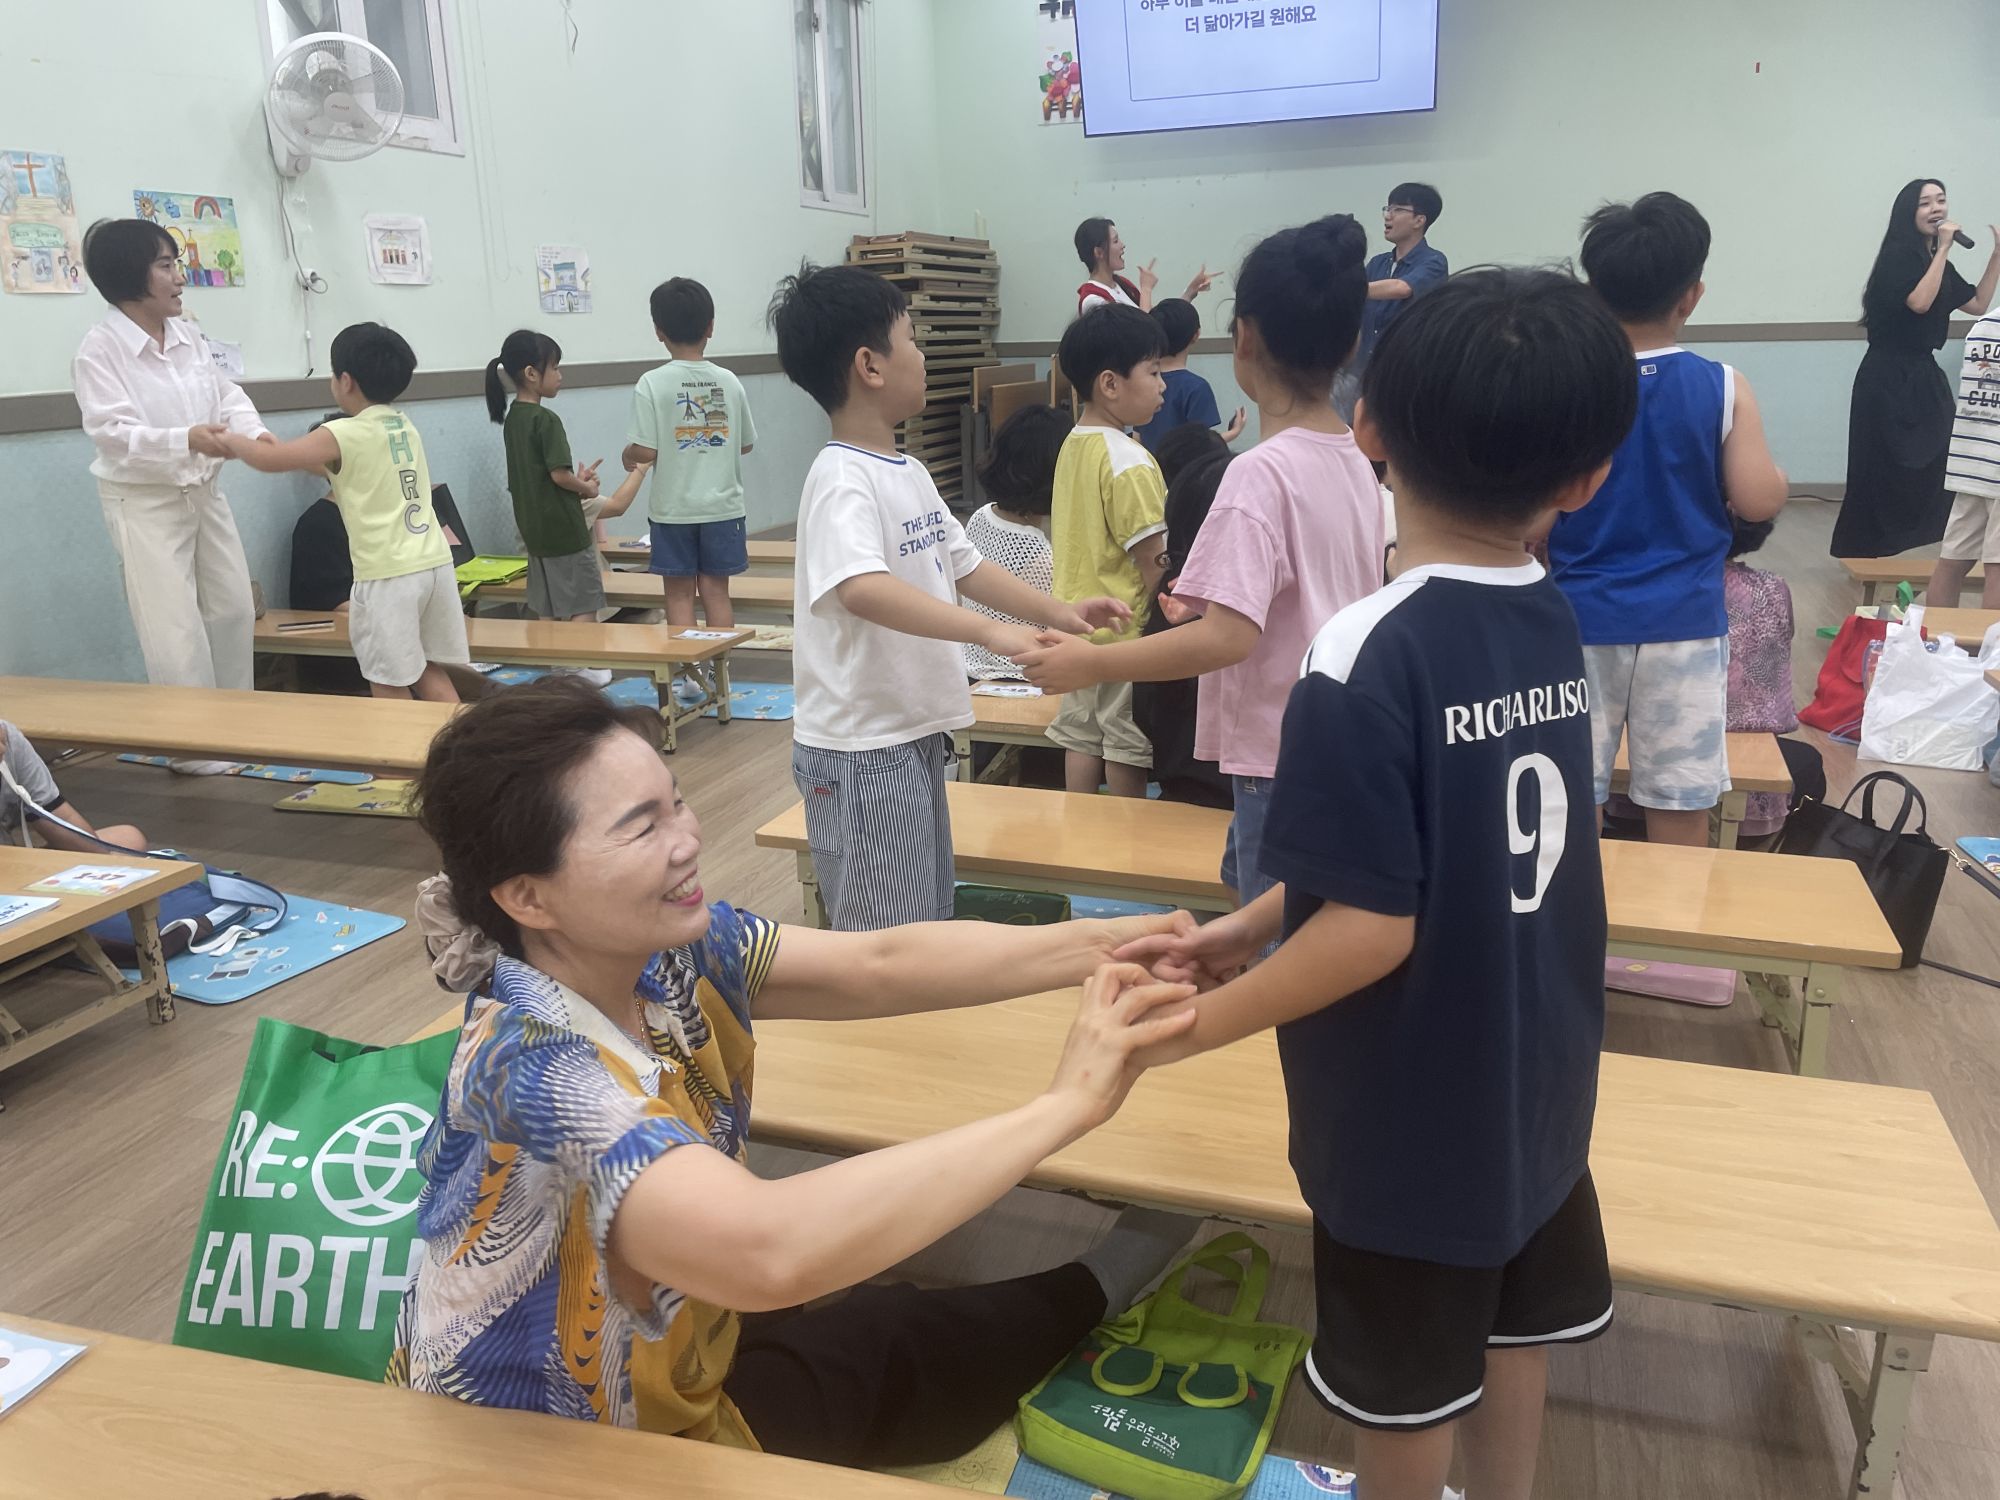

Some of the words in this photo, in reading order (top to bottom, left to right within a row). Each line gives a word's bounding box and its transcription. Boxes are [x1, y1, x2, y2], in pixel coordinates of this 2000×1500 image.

[1185, 16, 1200, 33] 더
[1203, 9, 1265, 33] 닮아가길
[1269, 5, 1317, 26] 원해요
[1444, 678, 1590, 745] RICHARLISO
[1506, 752, 1569, 914] 9
[218, 1110, 309, 1200] RE:
[187, 1230, 427, 1331] EARTH
